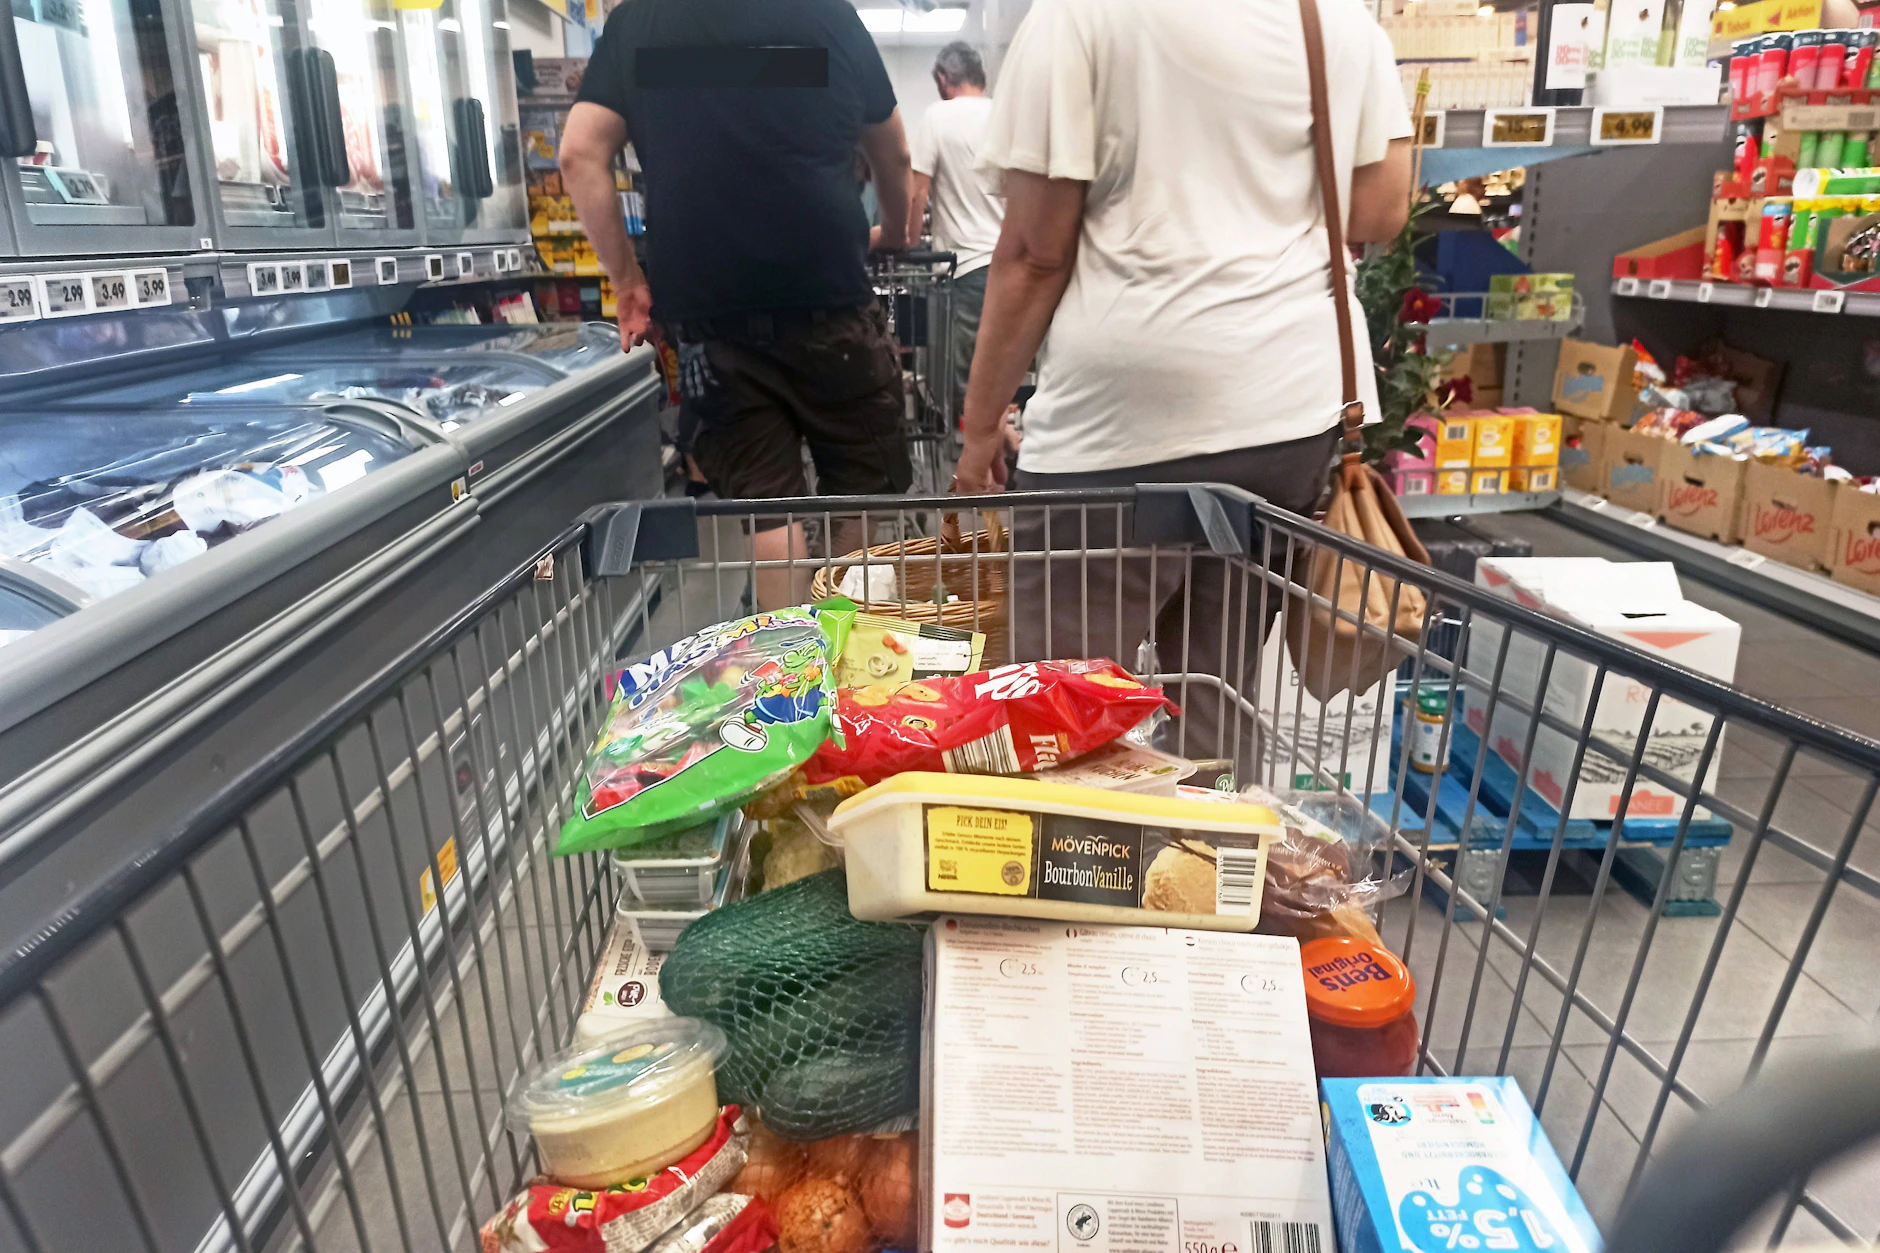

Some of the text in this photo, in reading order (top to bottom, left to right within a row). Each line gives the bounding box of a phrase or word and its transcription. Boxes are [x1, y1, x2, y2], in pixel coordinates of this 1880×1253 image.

[1615, 118, 1653, 134] 4.99
[63, 285, 84, 303] 2.99
[102, 282, 125, 300] 3.49
[144, 279, 165, 296] 3.99
[8, 288, 32, 308] 2.99
[1669, 482, 1718, 510] Lorenz
[1754, 505, 1815, 537] Lorenz
[956, 814, 972, 828] PICK
[975, 816, 993, 829] DEIN
[1051, 836, 1131, 860] MÖVENPICK
[1021, 963, 1037, 976] 2,5
[1307, 952, 1373, 979] Original
[1143, 971, 1158, 984] 2,5
[1262, 979, 1277, 992] 2,5
[1319, 962, 1393, 992] Ben's
[1426, 1209, 1468, 1221] FETT
